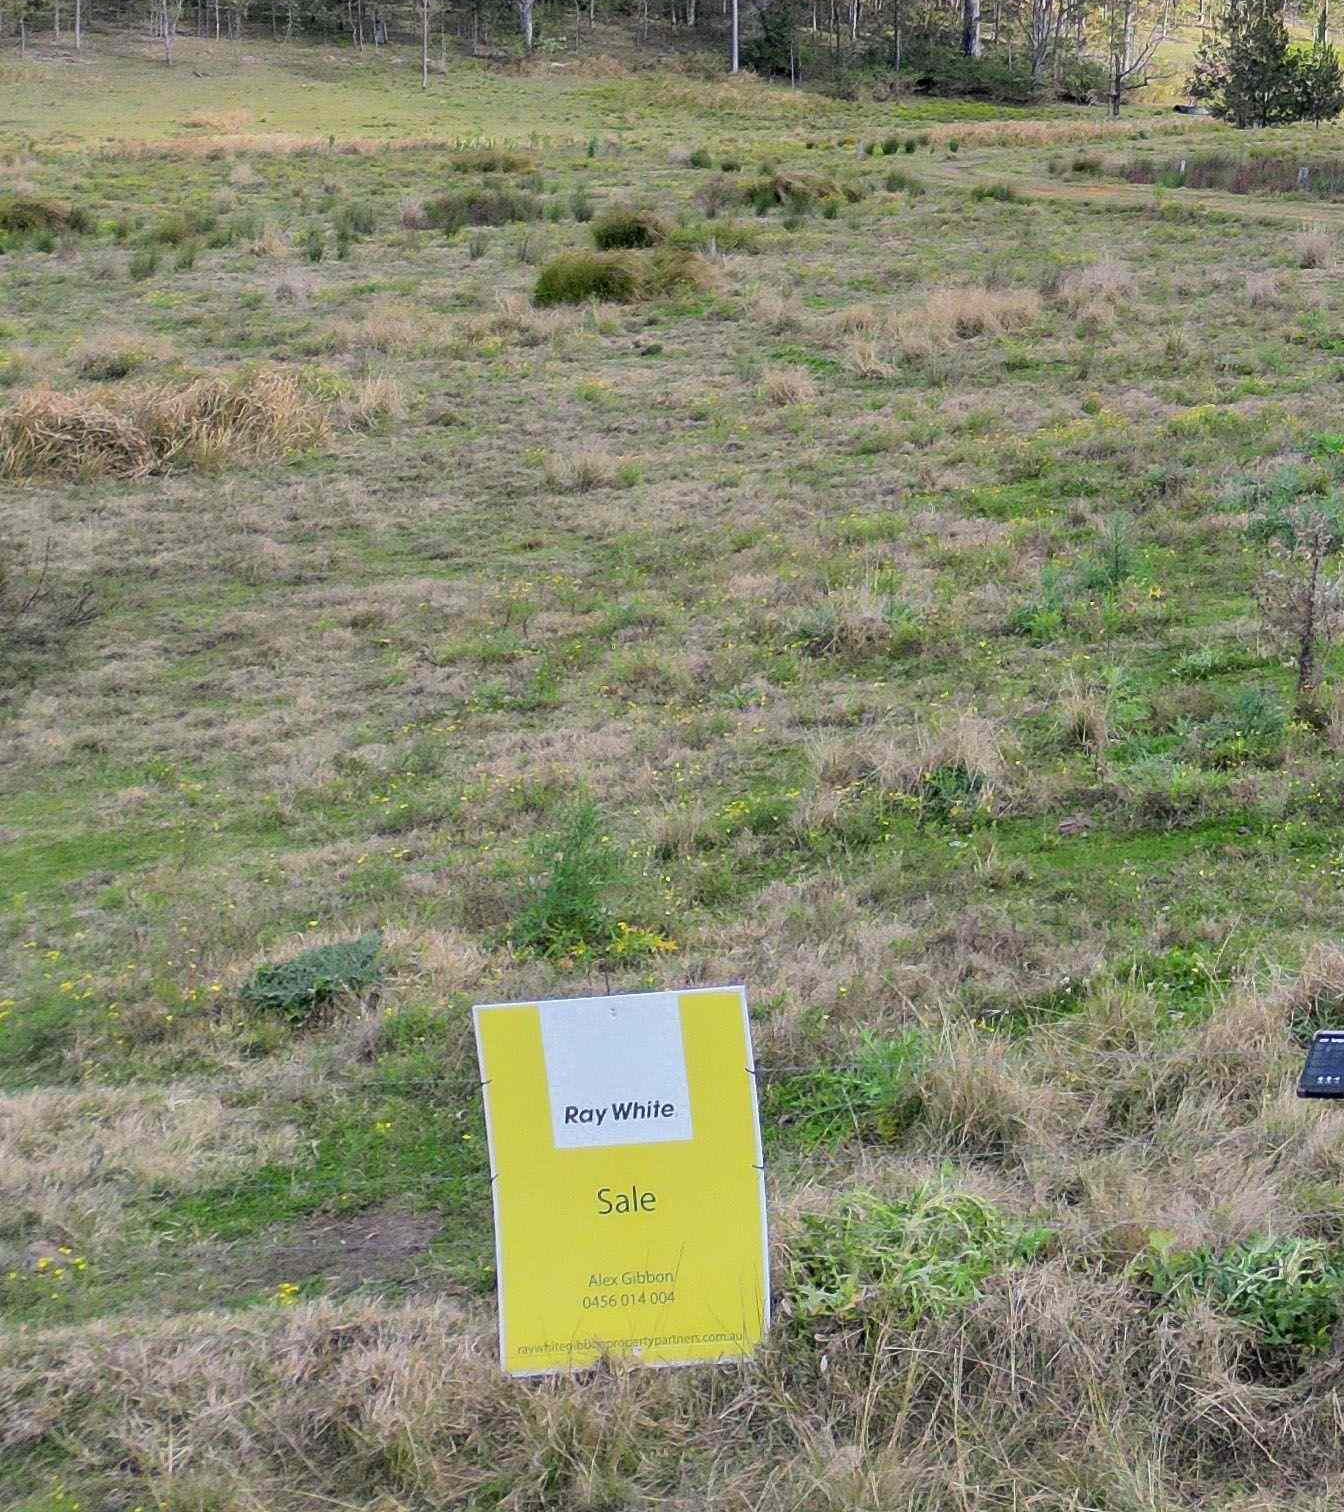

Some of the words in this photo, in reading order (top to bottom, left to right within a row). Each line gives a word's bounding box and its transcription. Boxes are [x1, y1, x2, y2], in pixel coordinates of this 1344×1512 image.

[565, 1106, 608, 1126] Ray
[612, 1100, 675, 1120] White
[597, 1185, 656, 1214] Sale
[588, 1273, 618, 1287] Alex
[621, 1270, 674, 1285] Gibbon
[582, 1295, 617, 1309] 0456
[620, 1292, 646, 1306] 014
[650, 1291, 675, 1305] 004
